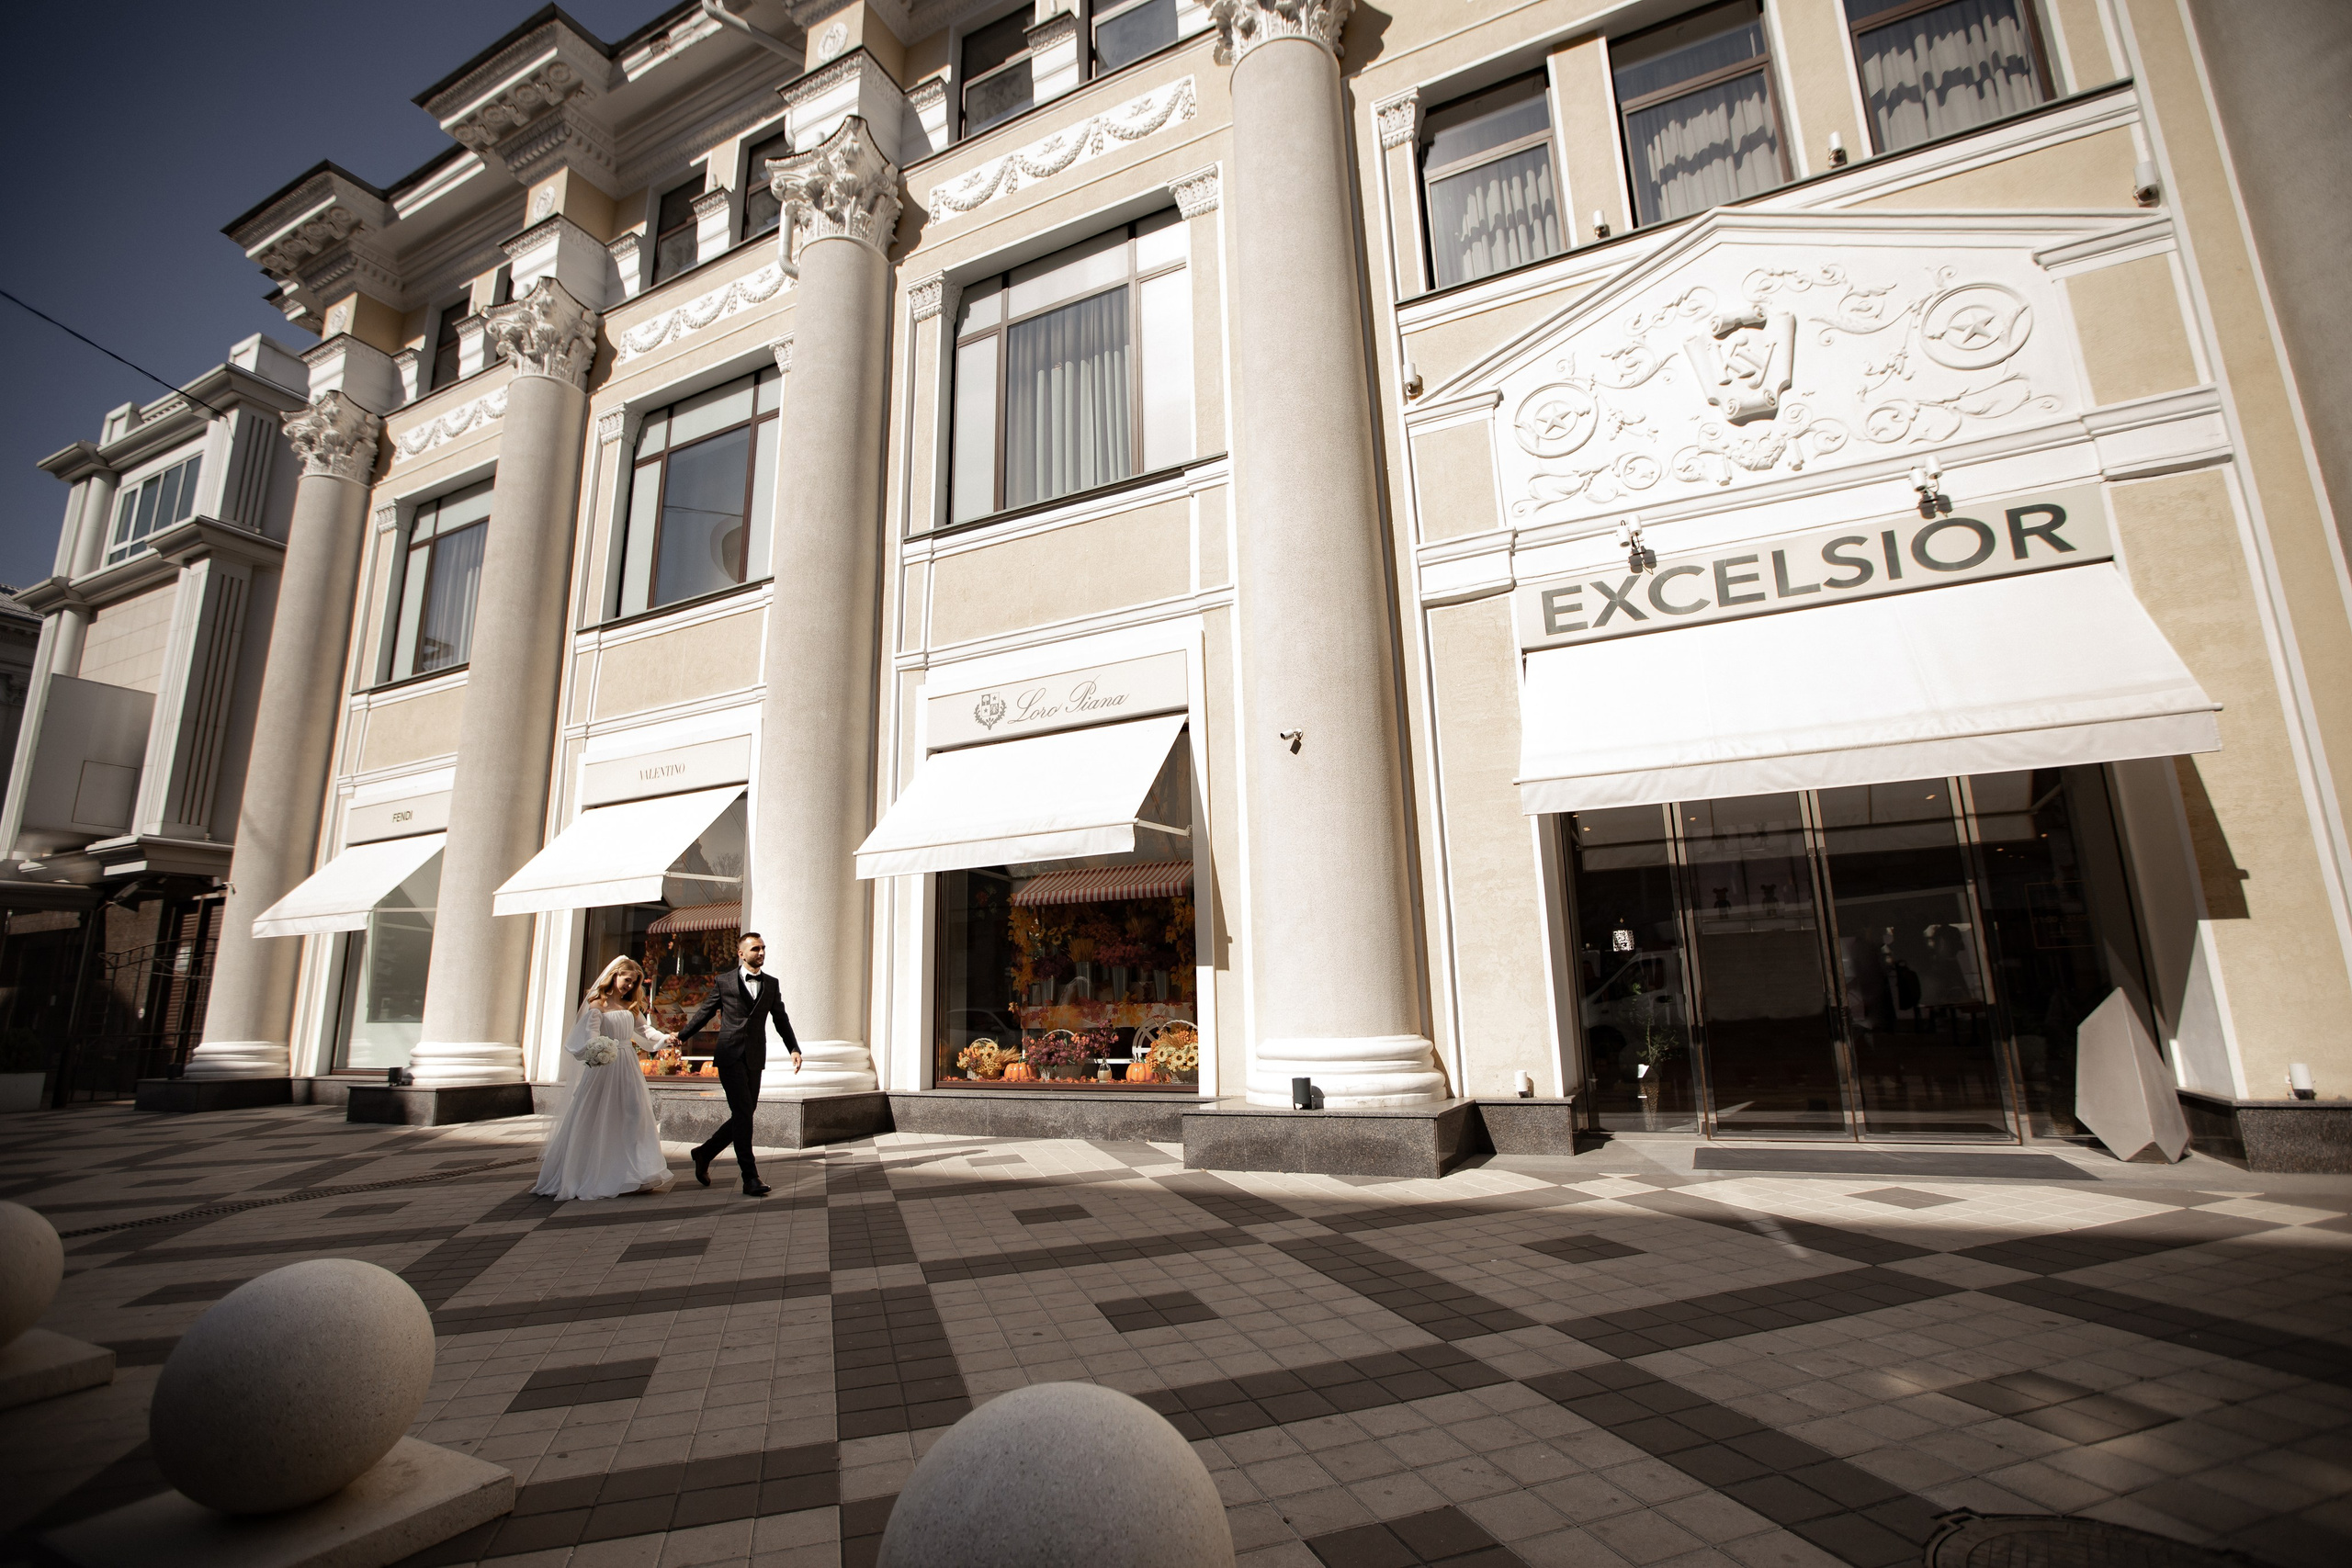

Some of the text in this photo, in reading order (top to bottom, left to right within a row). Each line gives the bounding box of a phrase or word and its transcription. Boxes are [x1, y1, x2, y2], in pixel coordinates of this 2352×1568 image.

[1541, 502, 2077, 637] EXCELSIOR
[1007, 674, 1130, 725] Loro Piana
[639, 763, 685, 781] VALENTINO
[392, 810, 413, 823] FENDI
